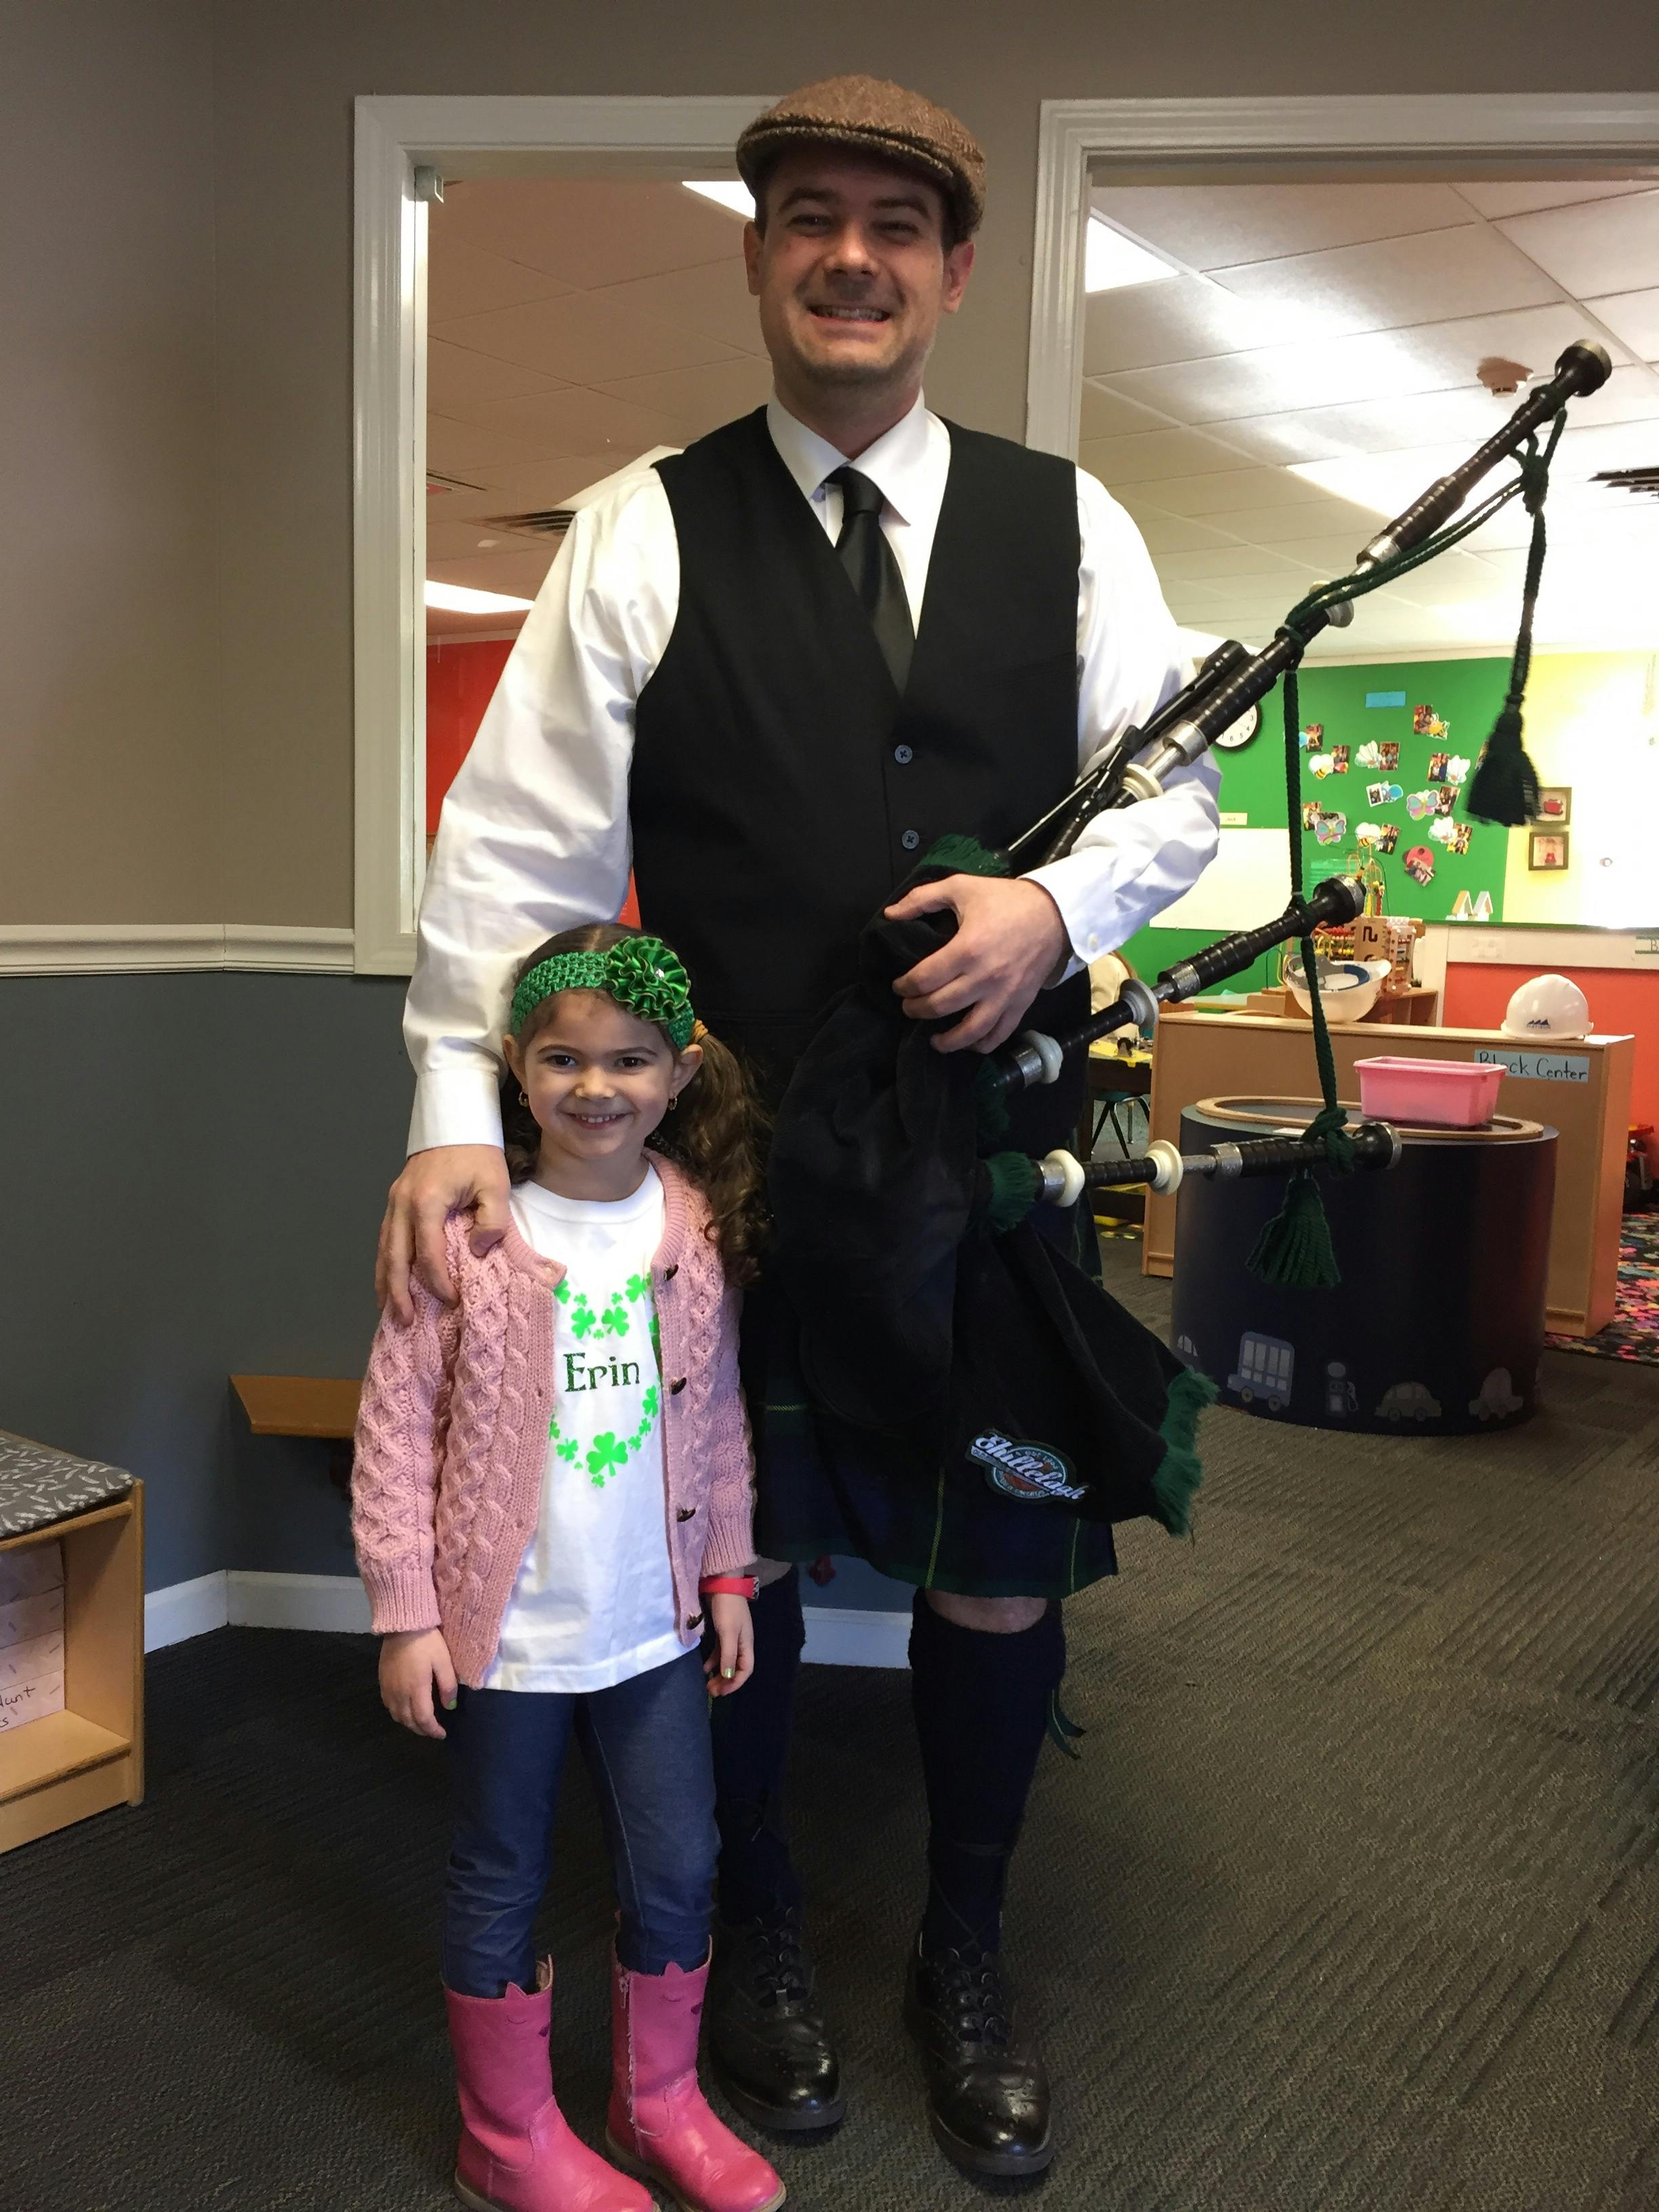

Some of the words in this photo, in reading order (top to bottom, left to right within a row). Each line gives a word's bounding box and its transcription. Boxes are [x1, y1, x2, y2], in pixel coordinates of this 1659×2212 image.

[1479, 1050, 1530, 1076] Blck
[1536, 1058, 1588, 1080] Center
[563, 1352, 640, 1392] Erin
